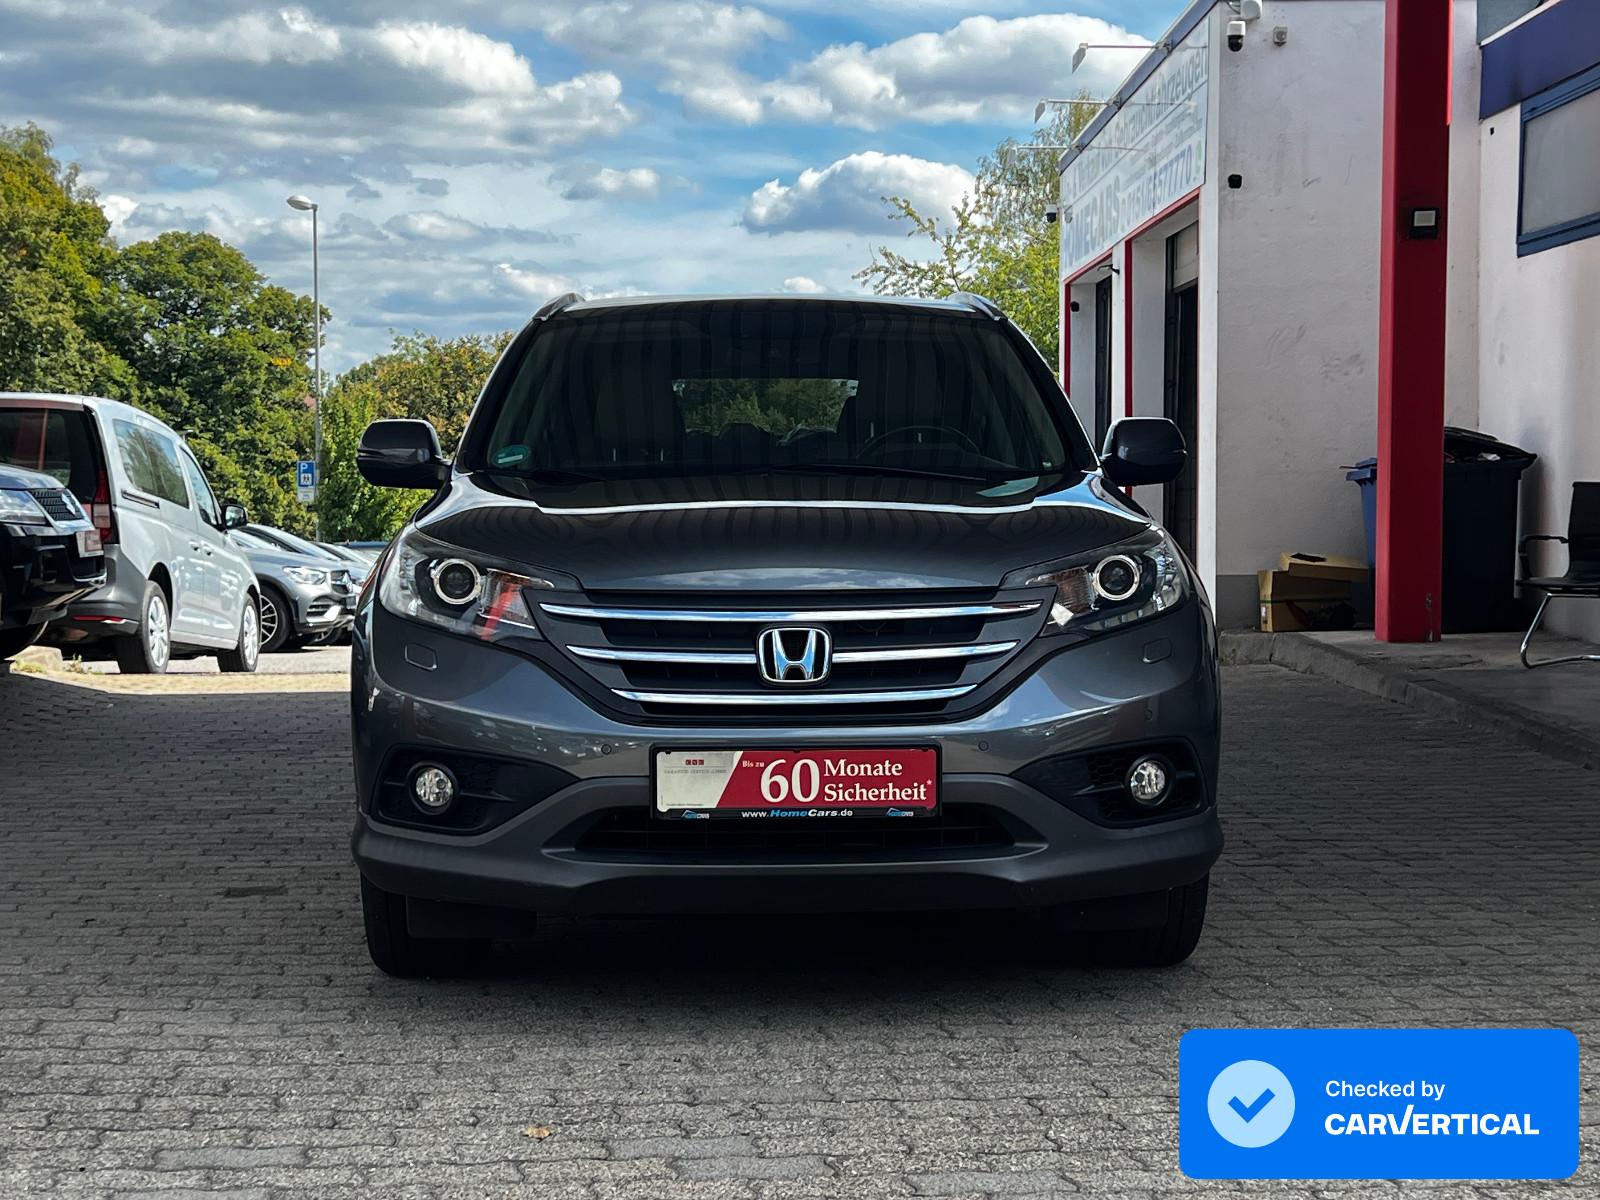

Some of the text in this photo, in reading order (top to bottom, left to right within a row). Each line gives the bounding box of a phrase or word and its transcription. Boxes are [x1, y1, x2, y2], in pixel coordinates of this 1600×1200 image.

[300, 463, 309, 474] P
[760, 758, 821, 803] 60
[823, 758, 903, 777] Monate
